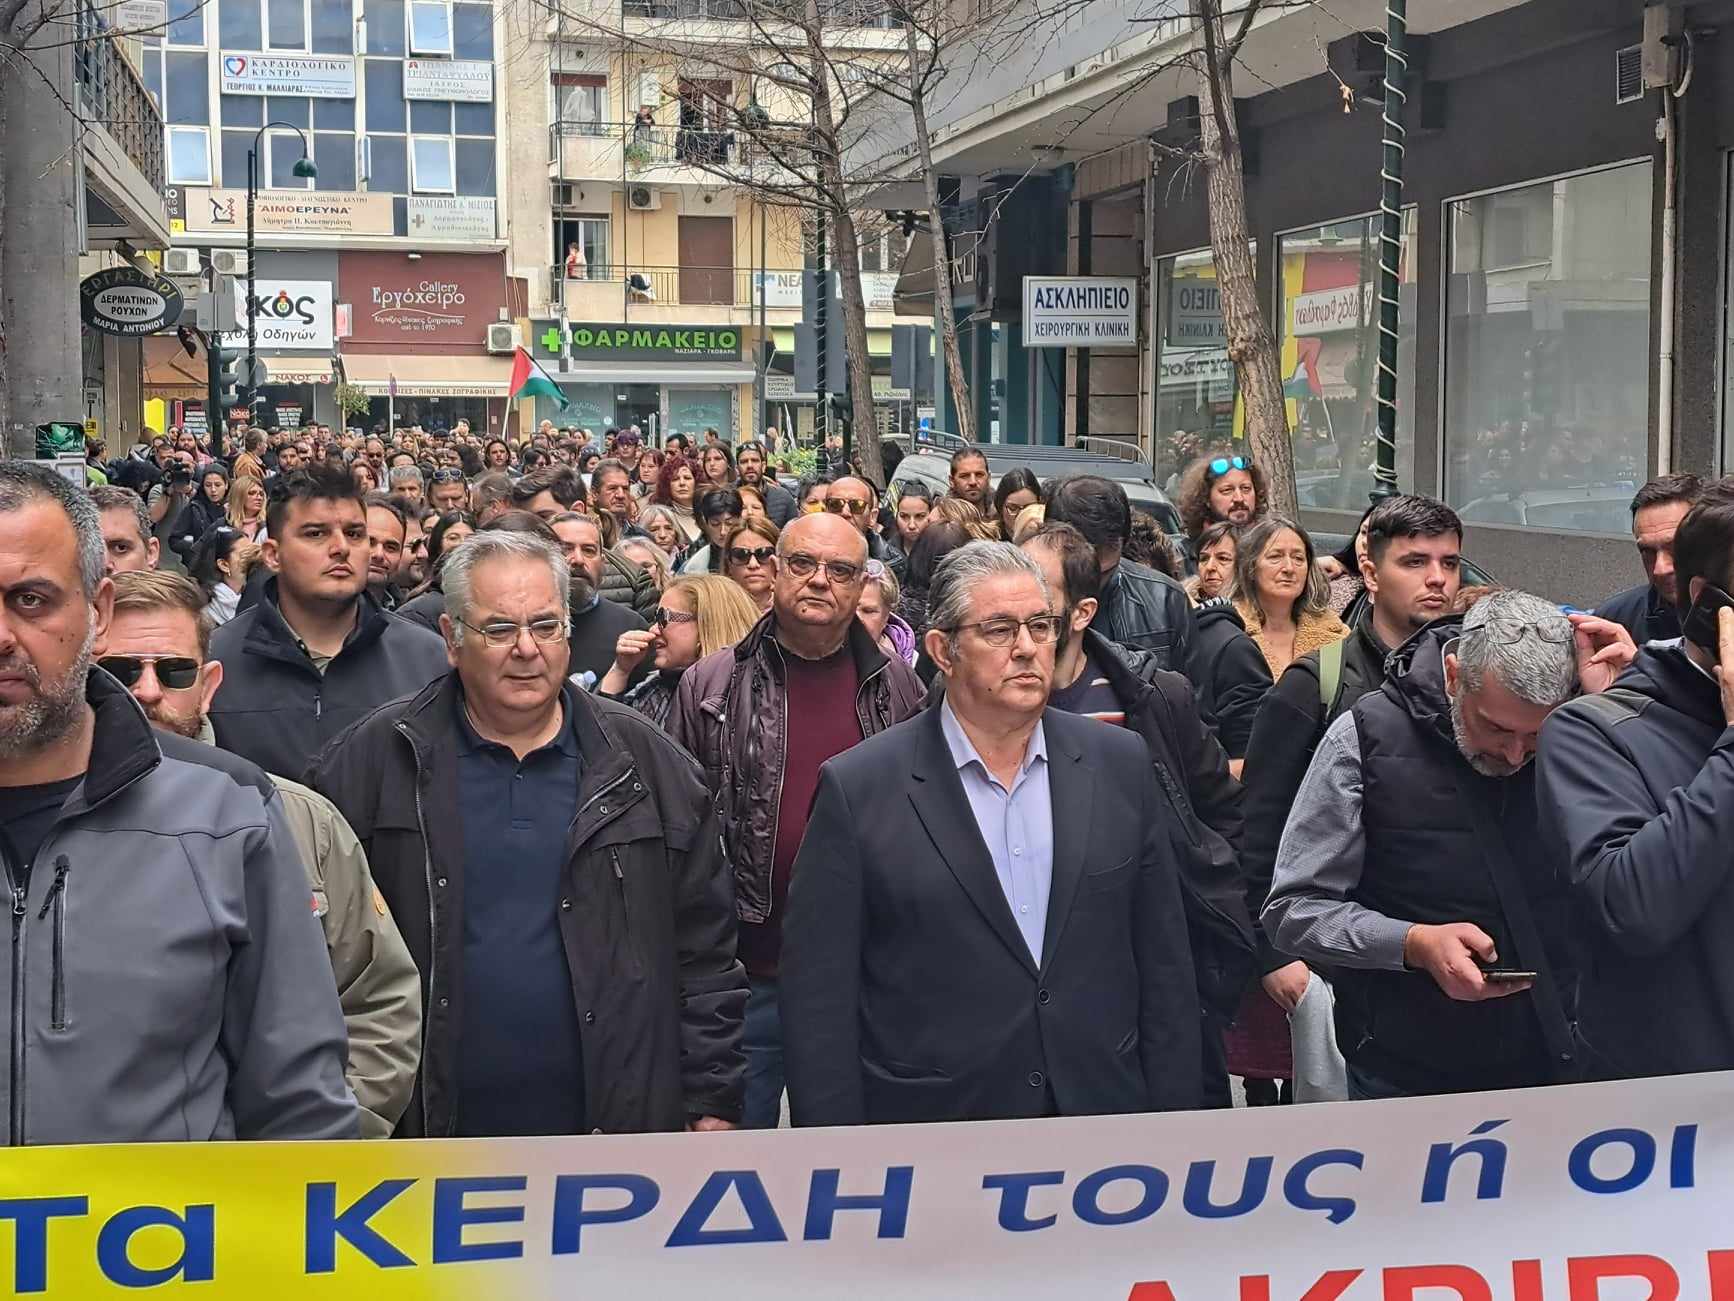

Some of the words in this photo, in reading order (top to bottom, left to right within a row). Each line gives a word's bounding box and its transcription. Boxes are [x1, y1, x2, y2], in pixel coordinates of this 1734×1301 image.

[252, 60, 346, 70] ΚΑΡΔΙΟΛΟΓΙΚΟ
[252, 69, 301, 78] ΚΕΝΤΡΟ
[227, 82, 256, 91] ΓΕΩΡΓΙΟΣ
[420, 280, 459, 295] Gallery
[101, 294, 158, 305] ΔΕΡΜΑΤΙΝΩΝ
[372, 286, 465, 309] Εργόχειρο
[1035, 286, 1130, 310] ΑΣΚΛΗΠΙΕΙΟ
[111, 306, 148, 316] ΡΟΥΧΩΝ
[93, 316, 119, 331] ΜΑΡΙΑ
[123, 318, 165, 332] ΑΝΤΩΝΙΟΥ
[1035, 321, 1090, 337] ΧΕΙΡΟΥΡΓΙΚΗ
[1095, 321, 1130, 337] ΚΛΙΝΙΚΗ
[263, 328, 317, 343] Οδηγών
[574, 328, 737, 349] ΦΑΡΜΑΚΕΙΟ
[275, 373, 312, 382] ΝΑΚΟΣ
[0, 1195, 215, 1293] Τα
[305, 1166, 914, 1274] ΚΕΡΔΗ
[982, 1149, 1364, 1232] τους
[1421, 1119, 1512, 1203] ή
[1568, 1124, 1698, 1194] οι
